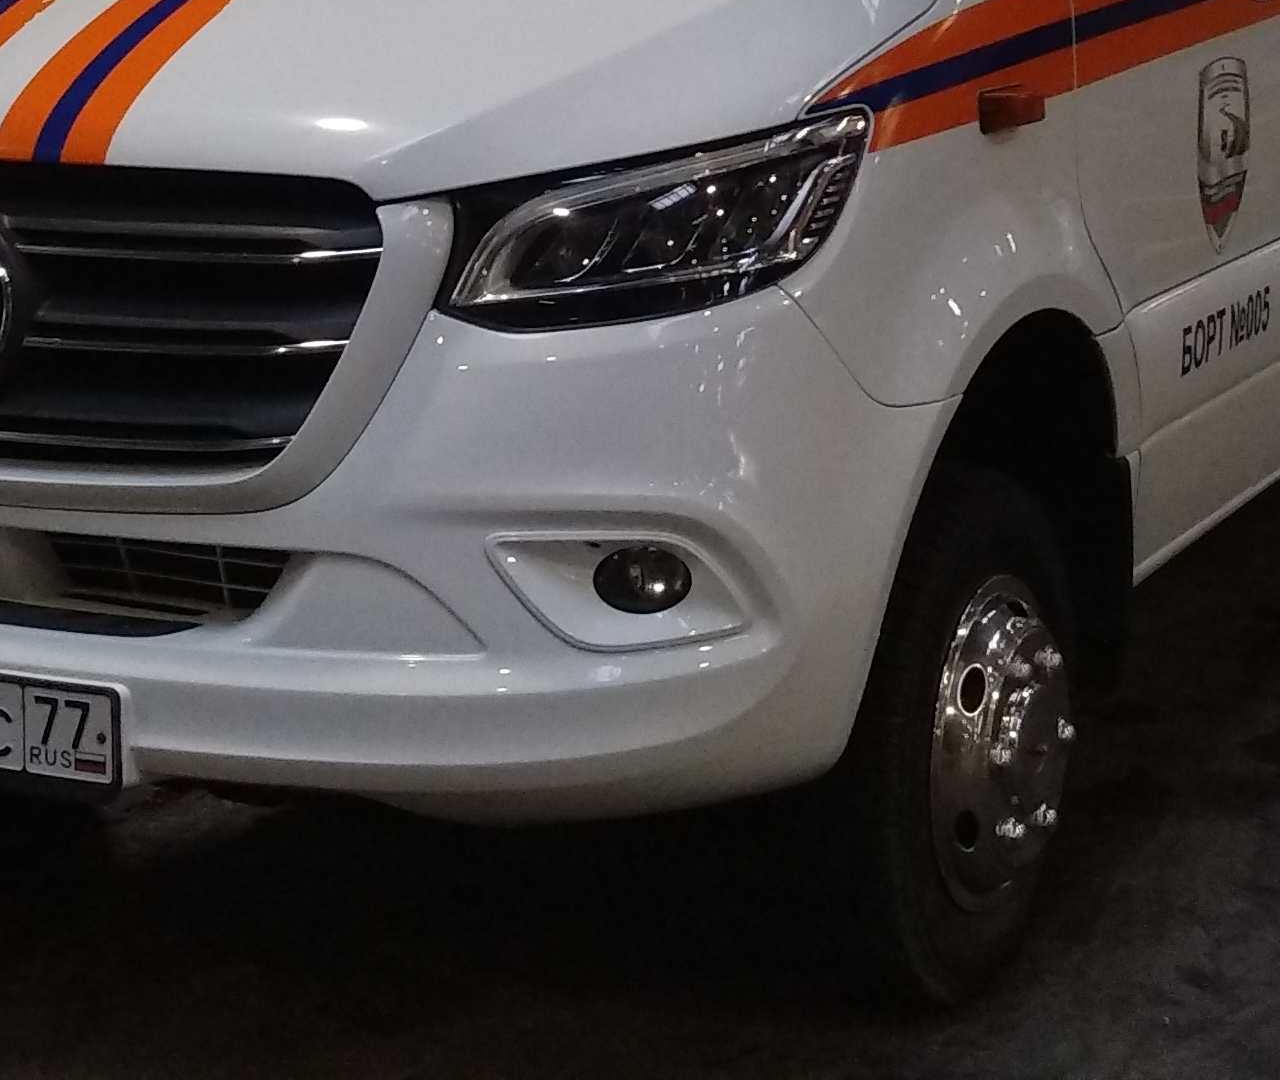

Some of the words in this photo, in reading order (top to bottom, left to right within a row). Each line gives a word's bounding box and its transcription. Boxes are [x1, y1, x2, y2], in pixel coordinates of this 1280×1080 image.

[1181, 307, 1226, 377] БОРТ
[1229, 286, 1270, 351] №005
[33, 695, 91, 750] 77
[29, 746, 72, 769] RUS
